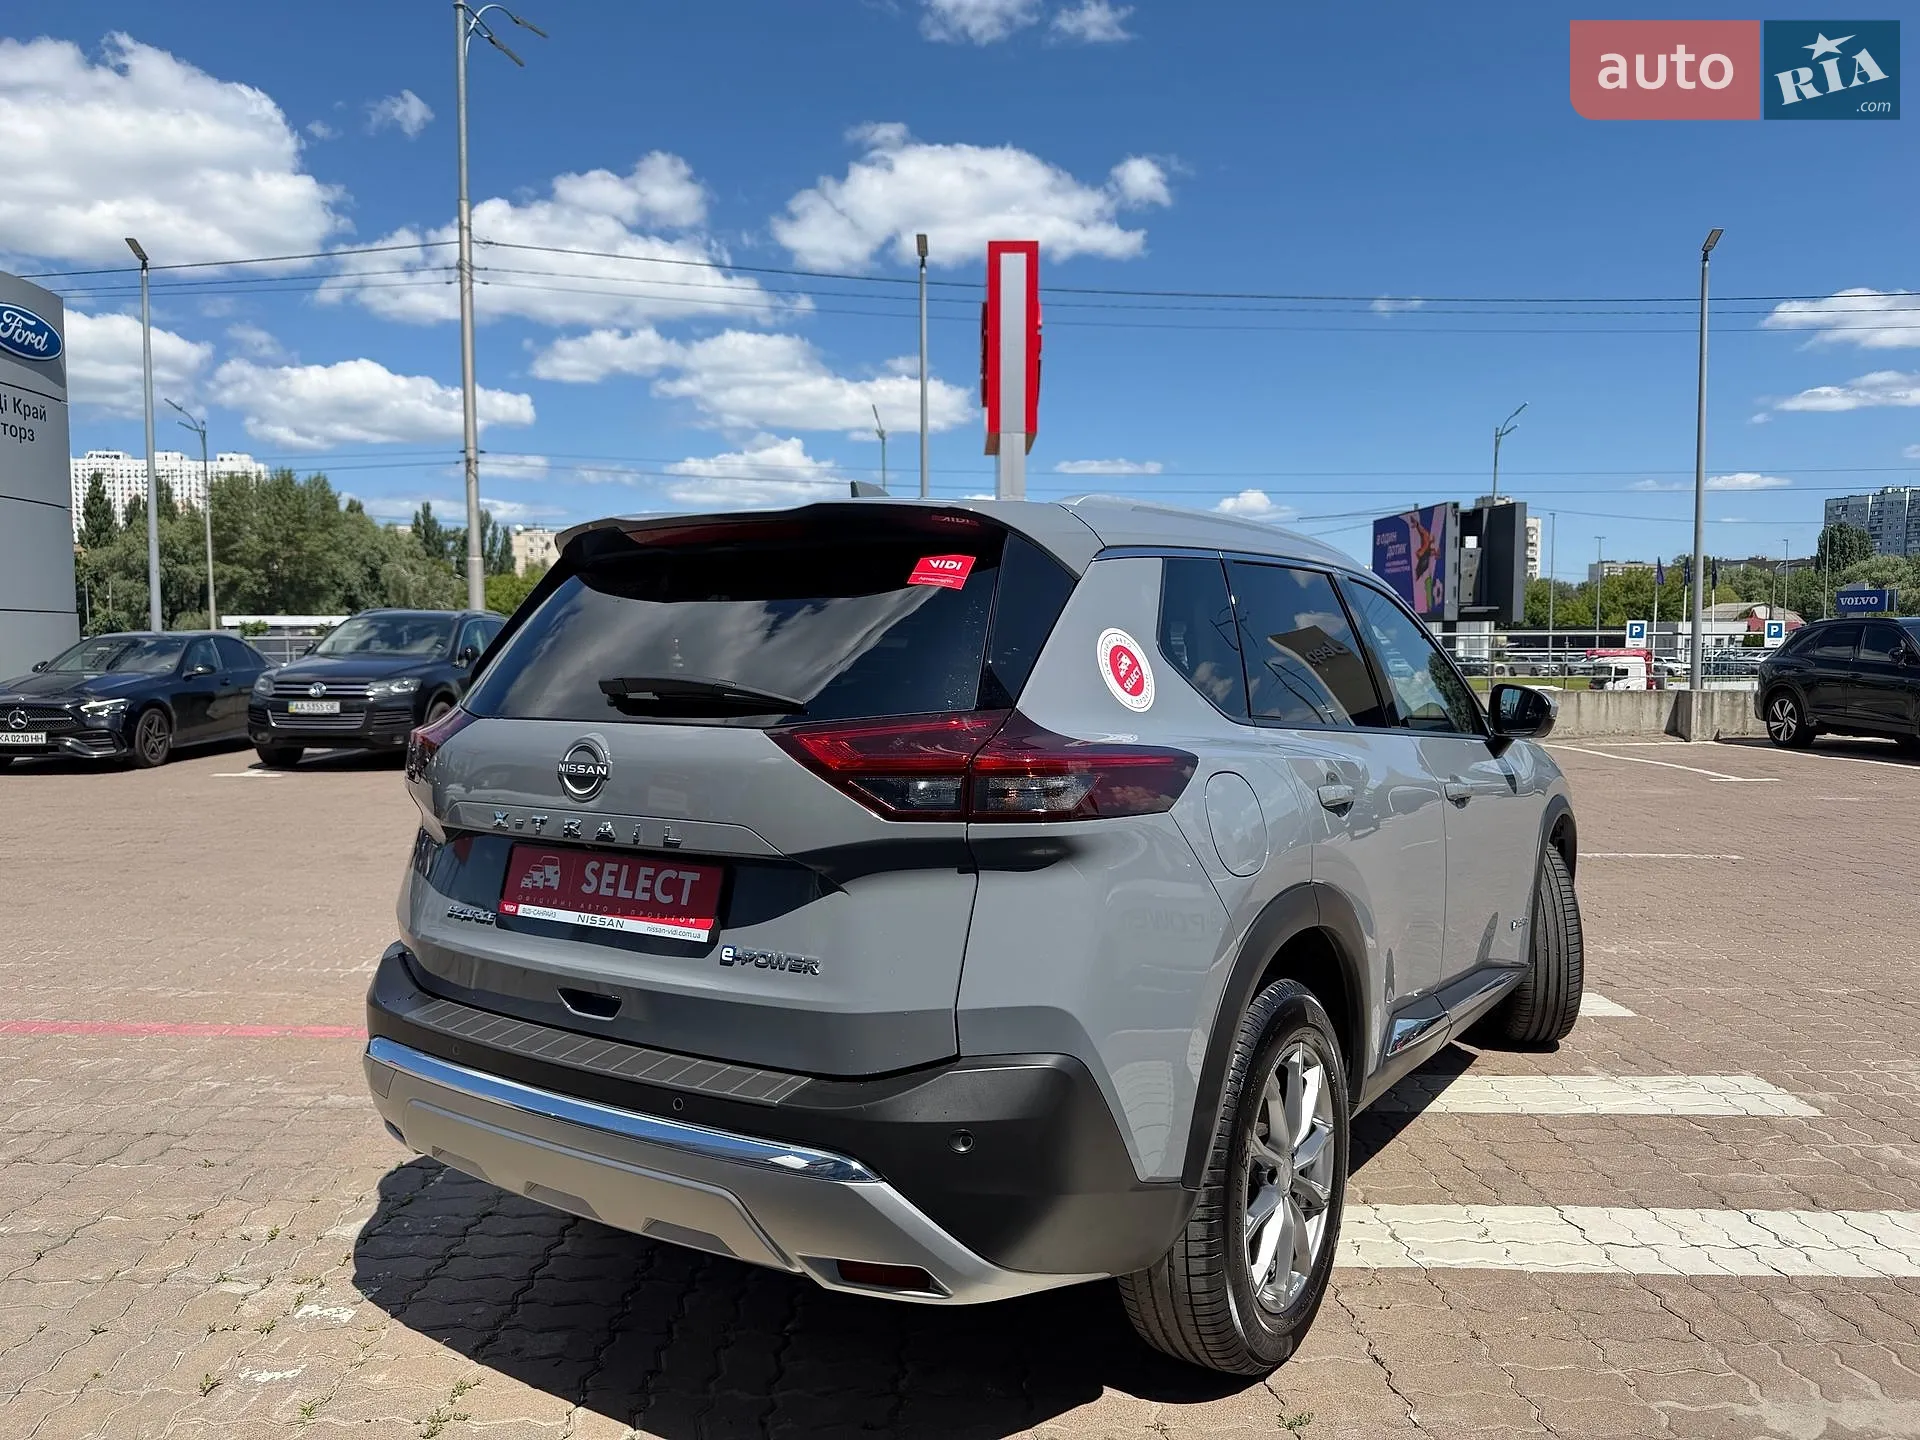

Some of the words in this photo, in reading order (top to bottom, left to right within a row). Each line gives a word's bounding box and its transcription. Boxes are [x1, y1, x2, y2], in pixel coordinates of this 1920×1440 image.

[0, 310, 48, 352] Ford
[13, 397, 47, 422] Край
[928, 559, 963, 571] VIDI
[1840, 596, 1879, 606] VOLVO
[1633, 625, 1641, 636] P
[1771, 625, 1779, 636] P
[1123, 665, 1142, 692] SELECT
[11, 734, 29, 743] 0210
[558, 763, 607, 776] NISSAN
[493, 810, 682, 849] X-TRAIL
[581, 860, 700, 906] SELECT
[576, 914, 625, 930] NISSAN
[646, 926, 701, 939] nissan-vidi.com.ua
[720, 945, 820, 975] e-POWER
